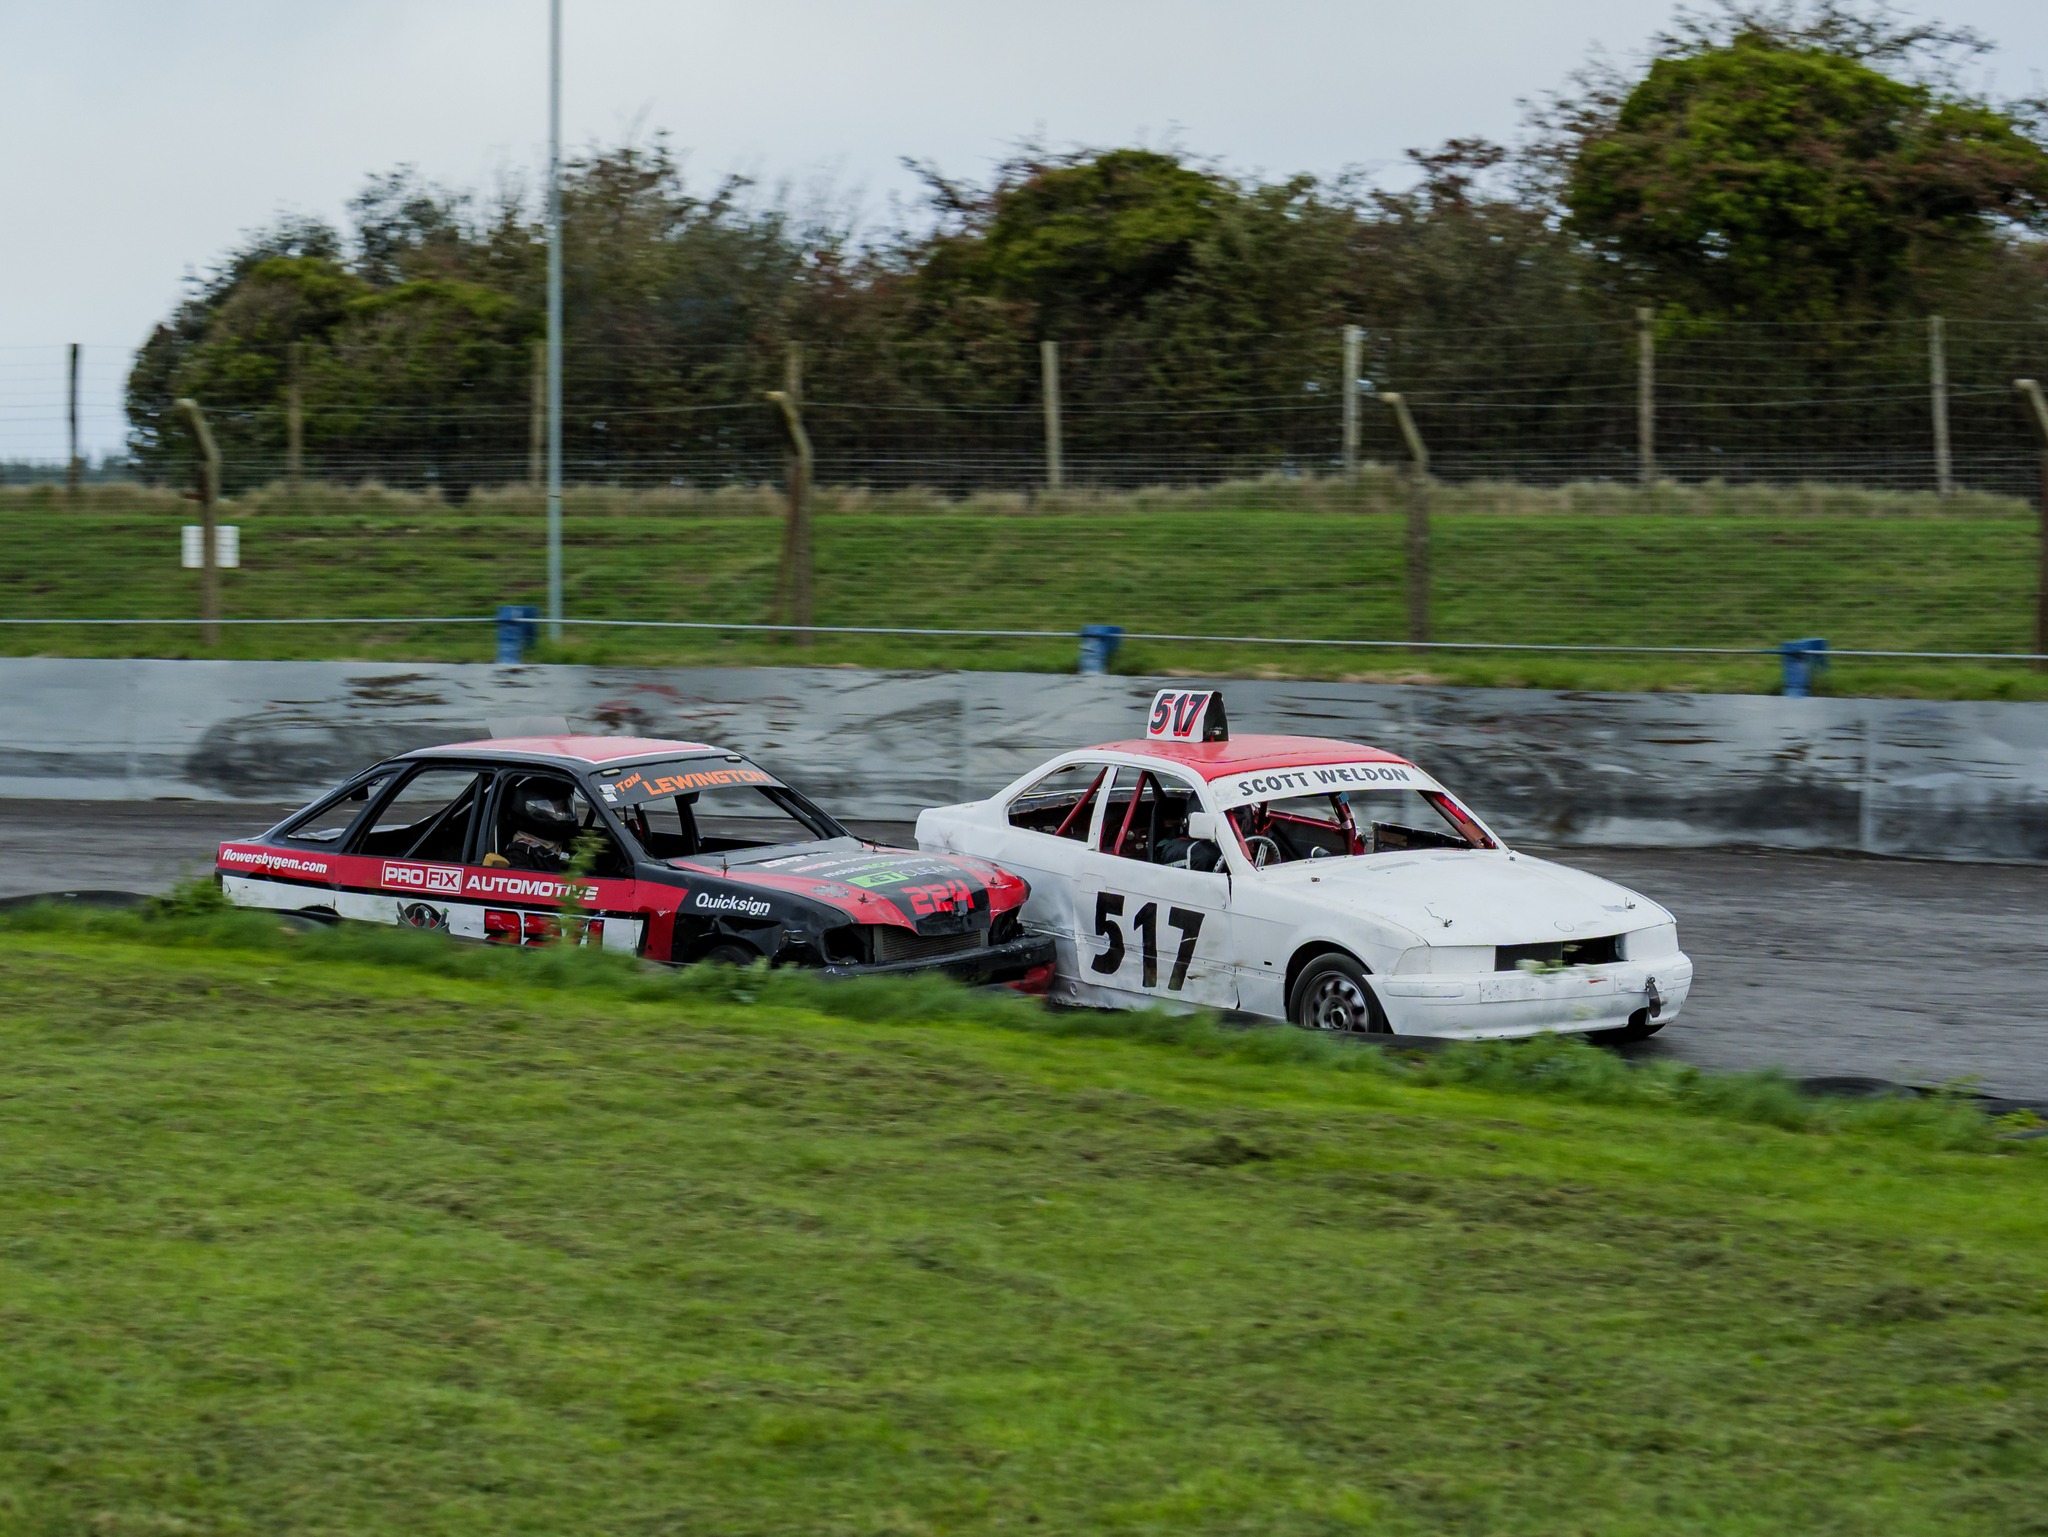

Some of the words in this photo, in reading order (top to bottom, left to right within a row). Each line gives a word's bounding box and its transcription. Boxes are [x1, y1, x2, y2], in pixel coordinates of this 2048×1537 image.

[1150, 693, 1209, 737] 517
[615, 772, 642, 793] TOM
[642, 769, 772, 796] LEWINGTON
[1238, 772, 1309, 797] SCOTT
[1313, 768, 1411, 785] WELDON
[222, 849, 328, 874] flowersbygem.com
[385, 866, 424, 885] PRO
[427, 871, 460, 889] FIX
[695, 892, 771, 916] Quicksign
[900, 879, 975, 915] 224
[1091, 891, 1205, 992] 517
